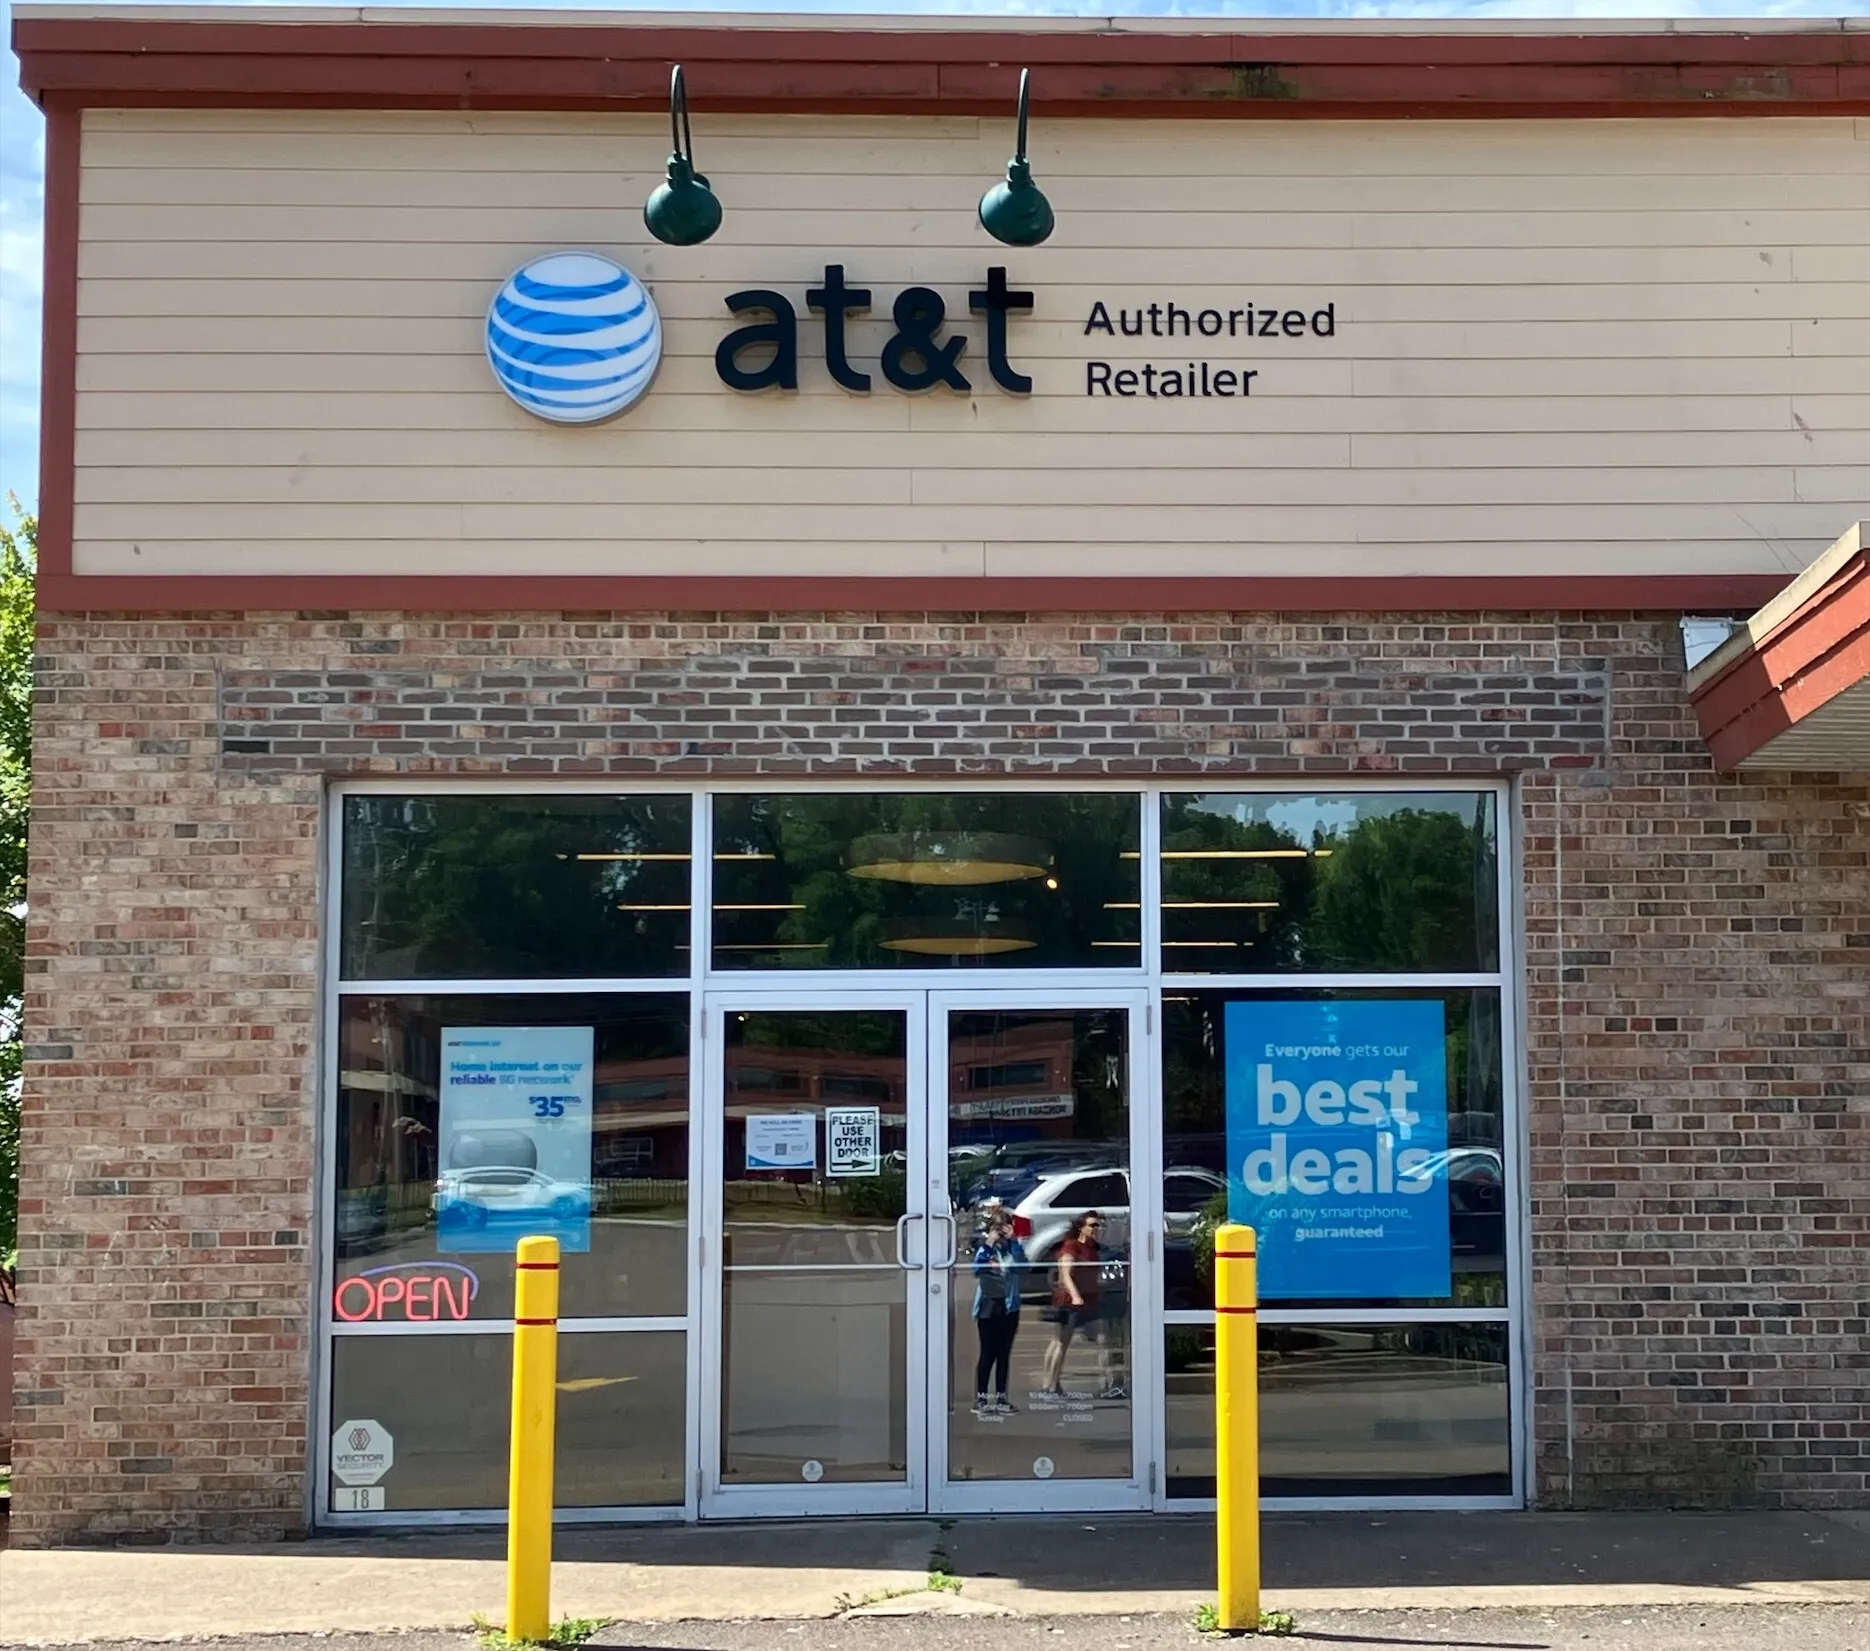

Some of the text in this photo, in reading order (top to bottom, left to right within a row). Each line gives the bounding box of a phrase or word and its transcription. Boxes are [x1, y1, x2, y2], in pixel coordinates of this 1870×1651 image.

[1083, 301, 1336, 338] Authorized
[715, 264, 1034, 397] at&t
[1084, 362, 1259, 399] Retailer
[1265, 1043, 1410, 1060] Everyone gets our
[450, 1061, 487, 1072] Home
[543, 1063, 559, 1072] on
[561, 1063, 583, 1072] our
[450, 1074, 496, 1085] reliable
[1256, 1063, 1420, 1127] best
[528, 1095, 565, 1117] $35
[832, 1115, 875, 1126] PLEASE
[842, 1126, 864, 1136] USE
[834, 1137, 872, 1147] OTHER
[837, 1147, 869, 1158] DOOR
[1242, 1132, 1434, 1196] deals
[1268, 1208, 1288, 1220] on
[1292, 1208, 1316, 1223] any
[1295, 1225, 1384, 1241] guaranteed
[335, 1276, 470, 1321] OPEN
[977, 1414, 1094, 1423] Sunday CLOSED
[336, 1454, 384, 1462] VECTOR
[351, 1488, 369, 1510] 18
